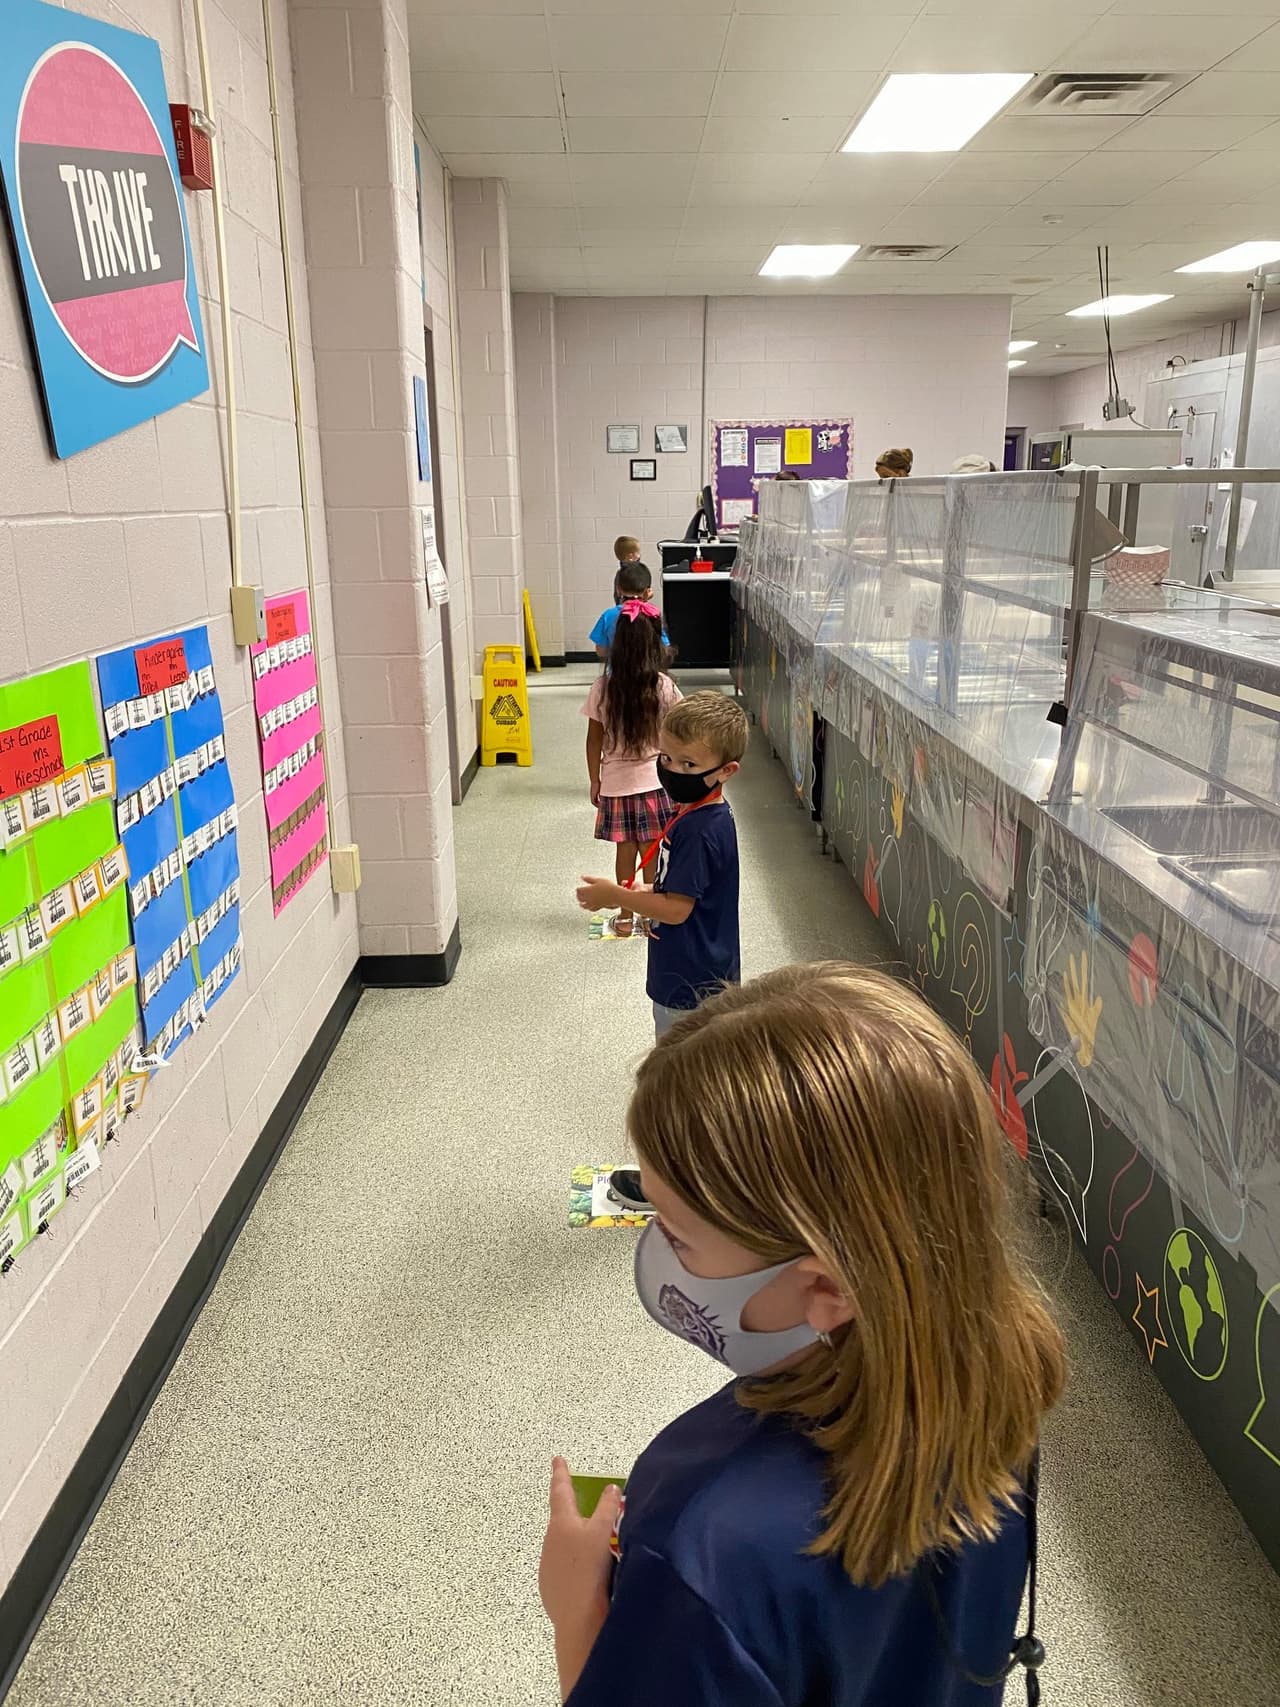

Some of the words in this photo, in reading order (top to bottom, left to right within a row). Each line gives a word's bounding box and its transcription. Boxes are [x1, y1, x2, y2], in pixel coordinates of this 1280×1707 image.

[174, 119, 185, 160] FIRE
[59, 164, 161, 282] THRIVE
[494, 679, 517, 688] CAUTION
[18, 725, 52, 747] Grade
